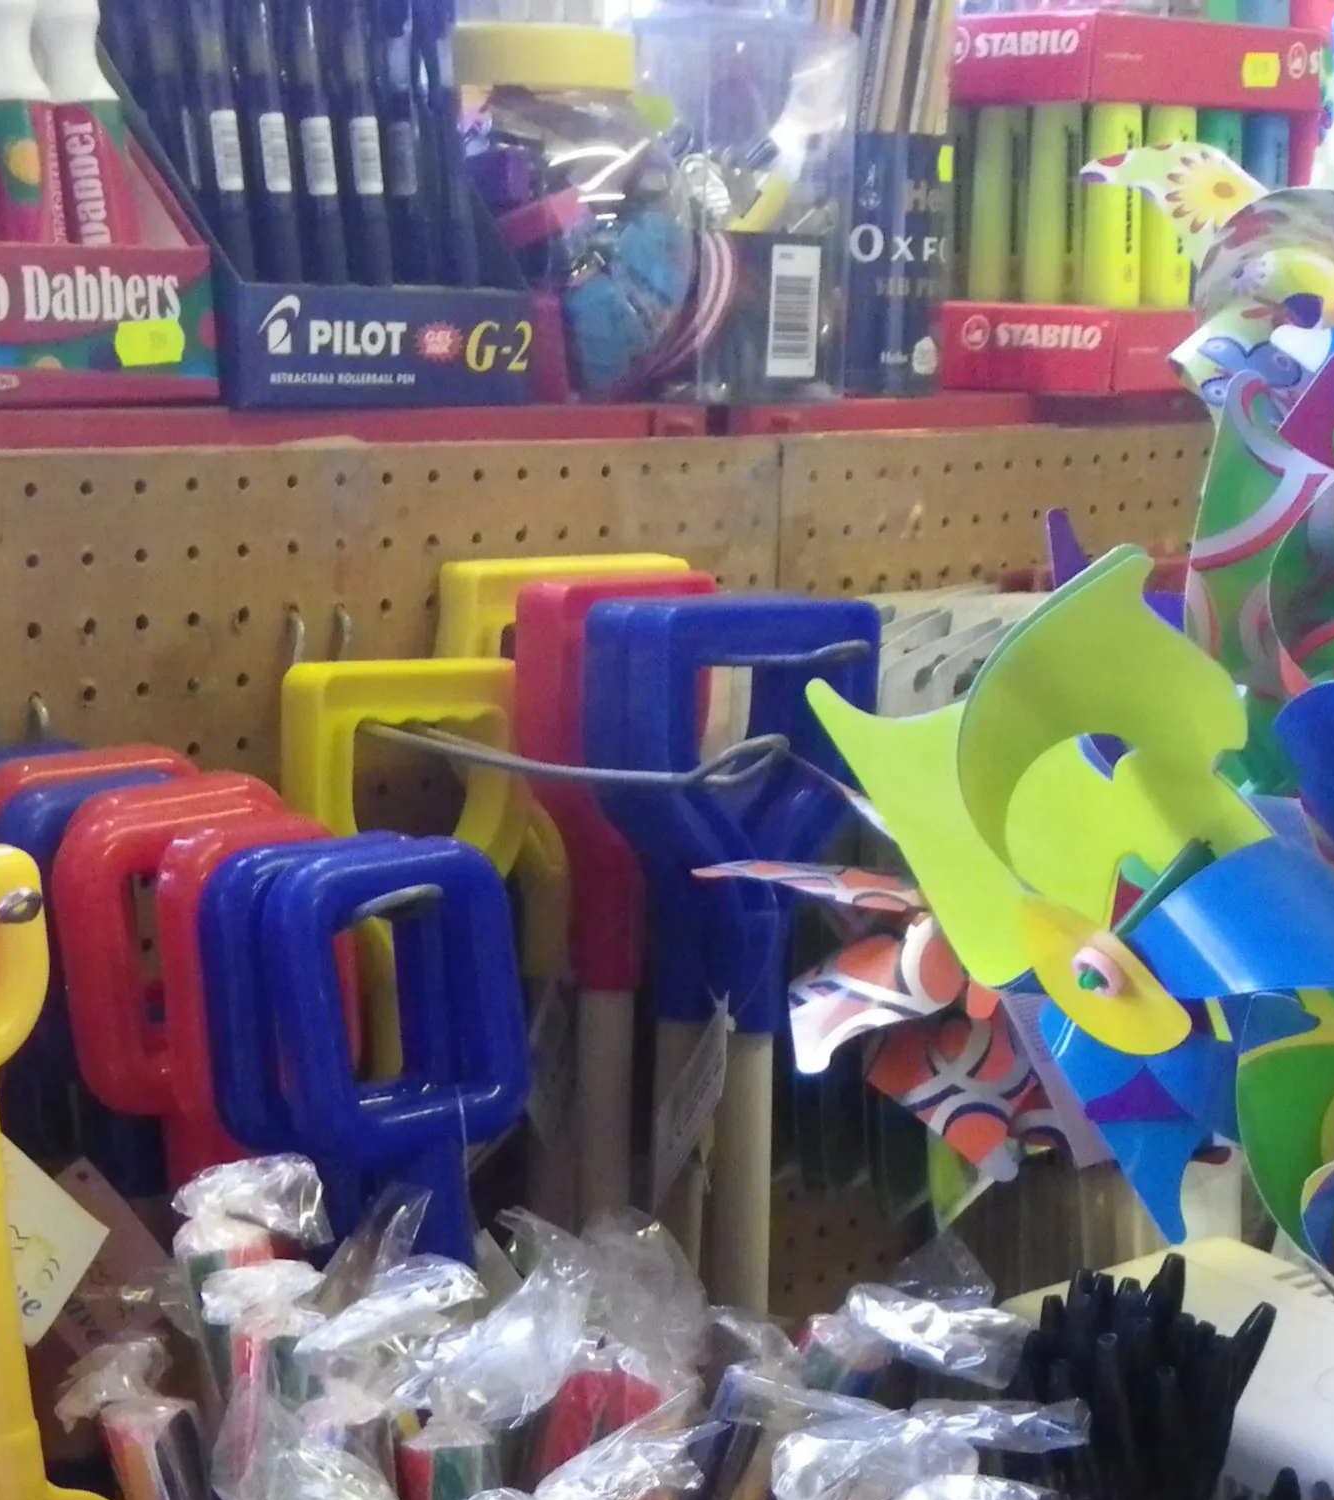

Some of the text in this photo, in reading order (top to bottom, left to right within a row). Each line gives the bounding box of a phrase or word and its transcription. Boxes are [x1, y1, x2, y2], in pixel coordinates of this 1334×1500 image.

[974, 28, 1079, 58] STABILO
[20, 264, 182, 323] Dabbers
[309, 319, 533, 373] PILOT G-2
[996, 322, 1103, 351] STABILO
[269, 371, 416, 385] RETRACTABLE ROLLERBALL PEN
